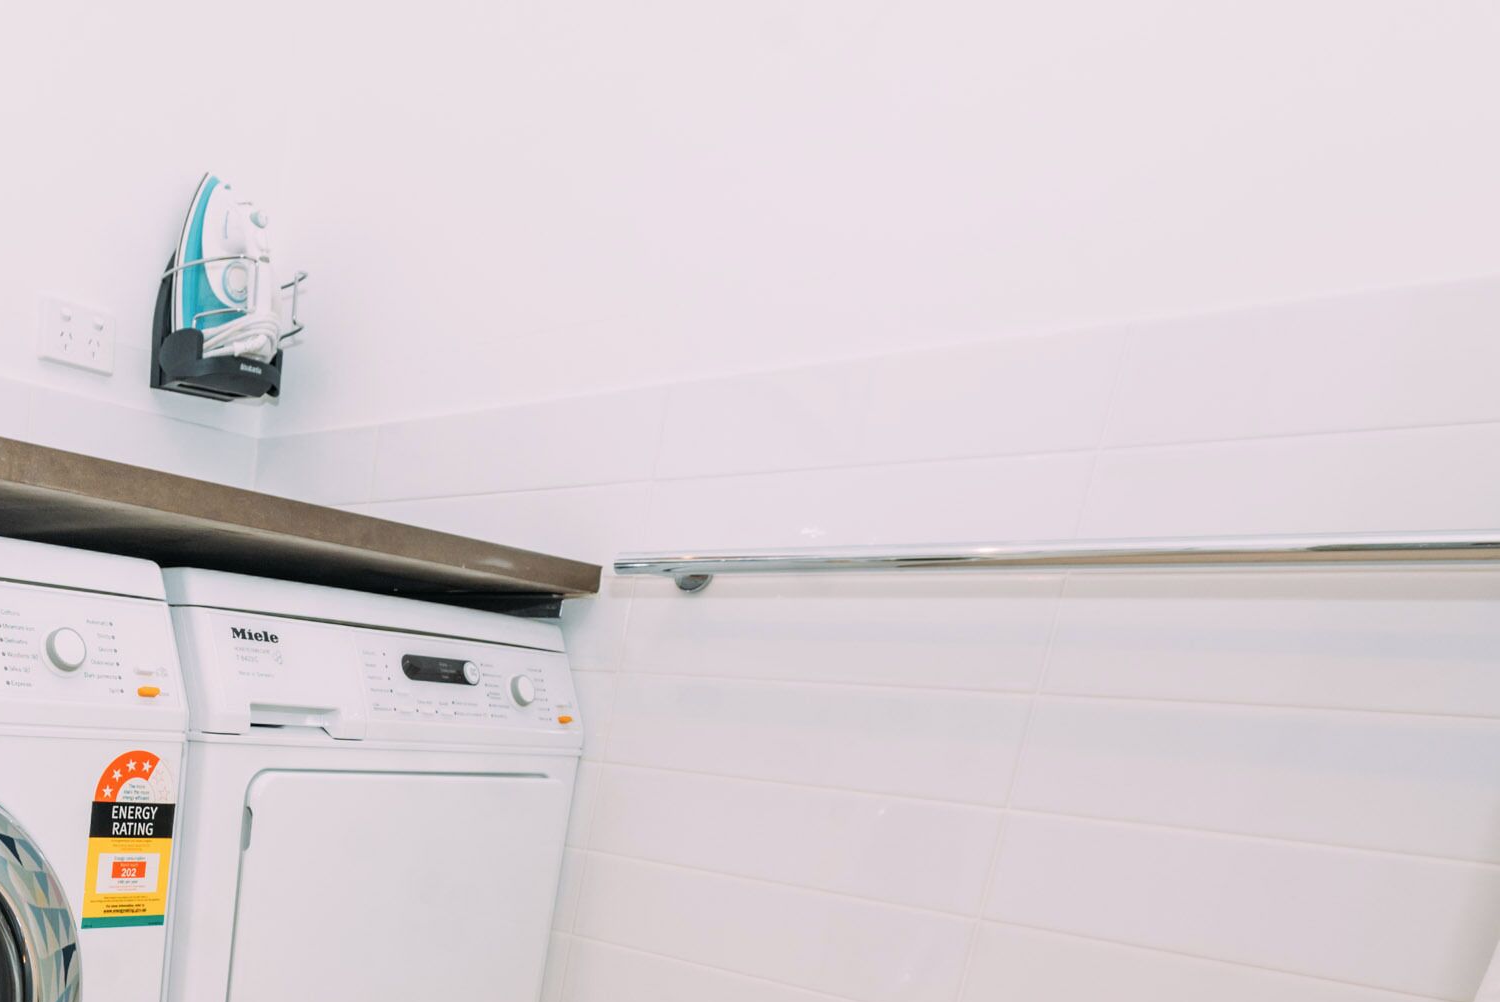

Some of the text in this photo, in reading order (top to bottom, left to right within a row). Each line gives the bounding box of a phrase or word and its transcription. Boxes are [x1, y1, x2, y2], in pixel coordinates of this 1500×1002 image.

[231, 627, 279, 643] Miele
[111, 805, 158, 820] ENERGY
[112, 822, 154, 836] RATING
[121, 868, 137, 877] 202
